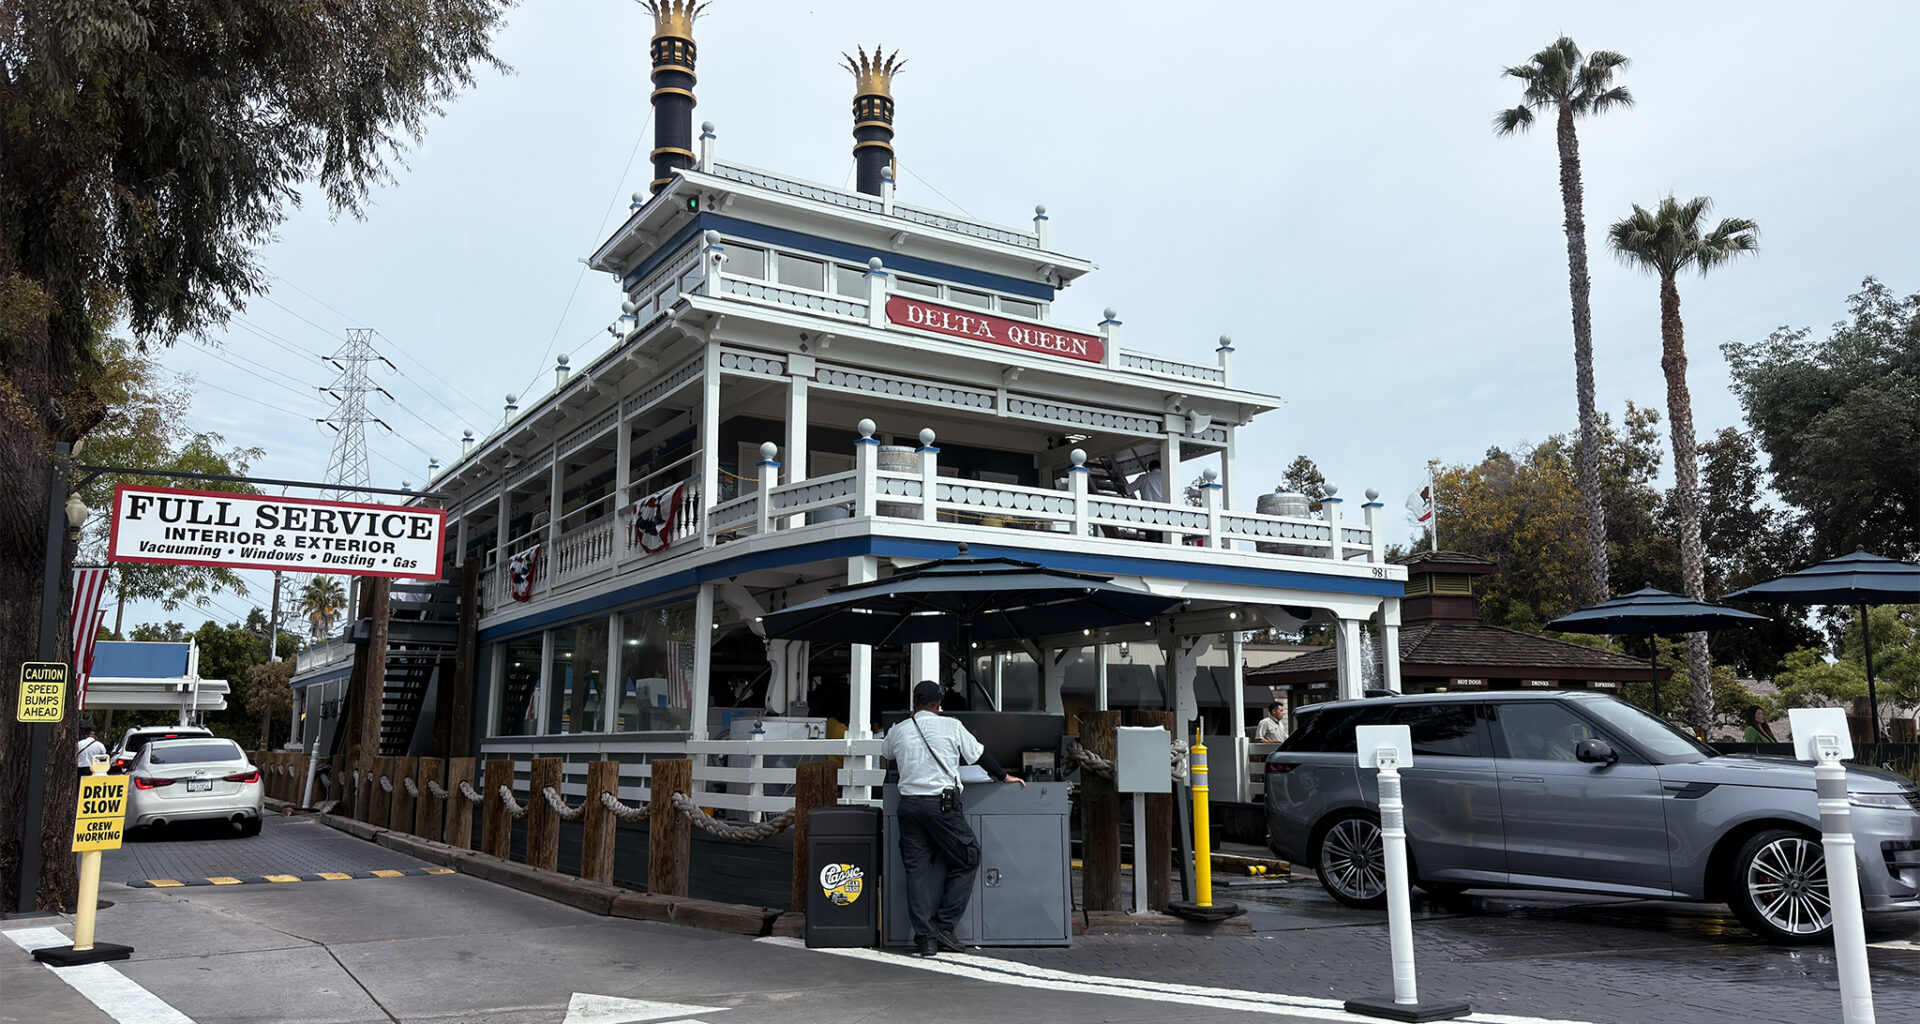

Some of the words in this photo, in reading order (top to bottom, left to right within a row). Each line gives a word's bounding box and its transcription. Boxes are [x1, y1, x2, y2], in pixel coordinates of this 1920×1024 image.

[907, 304, 996, 339] DELTA
[1007, 325, 1089, 356] QUEEN
[125, 494, 241, 527] FULL
[255, 504, 433, 540] SERVICE
[164, 527, 266, 546] INTERIOR
[273, 534, 287, 547] &
[294, 535, 396, 554] EXTERIOR
[139, 540, 222, 559] Vacuuming
[240, 547, 305, 562] Windows
[322, 552, 376, 568] Dusting
[393, 557, 418, 569] Gas
[1372, 567, 1387, 579] 981
[25, 668, 64, 680] CAUTION
[27, 684, 59, 694] SPEED
[25, 695, 59, 706] BUMPS
[23, 707, 58, 717] AHEAD
[83, 785, 124, 799] DRIVE
[82, 799, 121, 814] SLOW
[87, 821, 113, 832] CREW
[76, 830, 121, 843] WORKING
[820, 863, 864, 890] Classic
